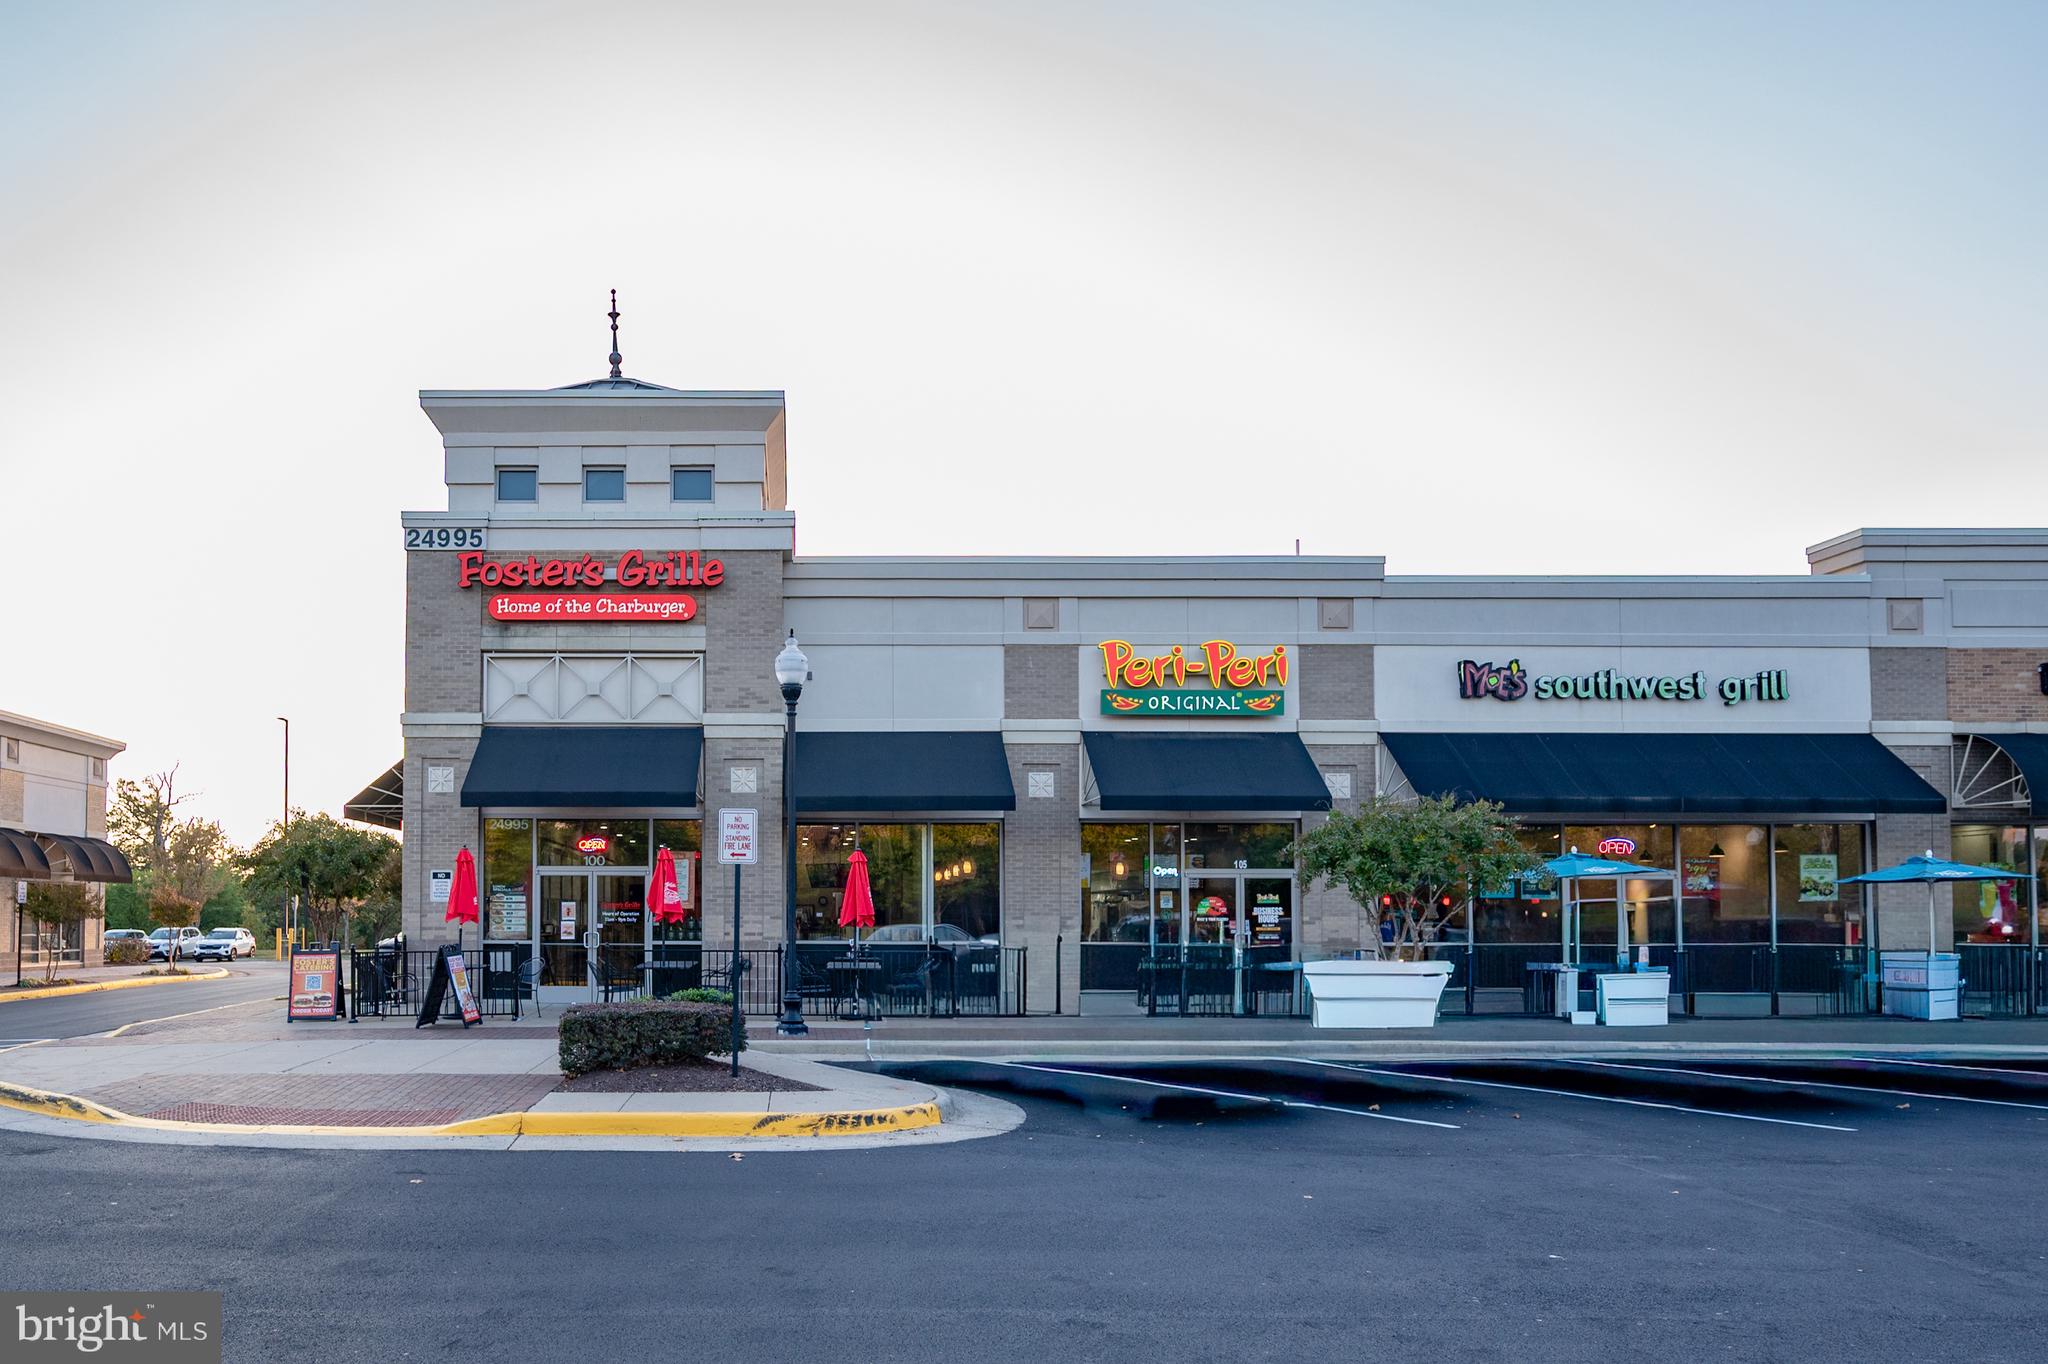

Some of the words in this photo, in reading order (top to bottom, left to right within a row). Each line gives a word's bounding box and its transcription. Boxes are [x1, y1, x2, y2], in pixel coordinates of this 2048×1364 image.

[406, 528, 483, 548] 24995
[457, 550, 605, 588] Foster's
[616, 549, 725, 588] Grille
[497, 599, 541, 614] Home
[545, 599, 562, 614] of
[565, 600, 591, 614] the
[595, 598, 686, 618] Charburger
[1099, 640, 1289, 689] Peri-Peri
[1535, 669, 1706, 700] southwest
[1719, 669, 1790, 706] grill
[1148, 695, 1241, 711] ORIGINAL
[489, 818, 529, 830] 24995
[579, 840, 606, 850] OPEN
[724, 842, 736, 851] FIRE
[737, 842, 752, 851] LANE
[1599, 841, 1632, 854] OPEN
[583, 855, 606, 866] 100
[1233, 860, 1247, 869] 105
[1153, 866, 1178, 877] Open
[1253, 907, 1283, 915] BUSINESS
[1258, 915, 1279, 923] HOURS
